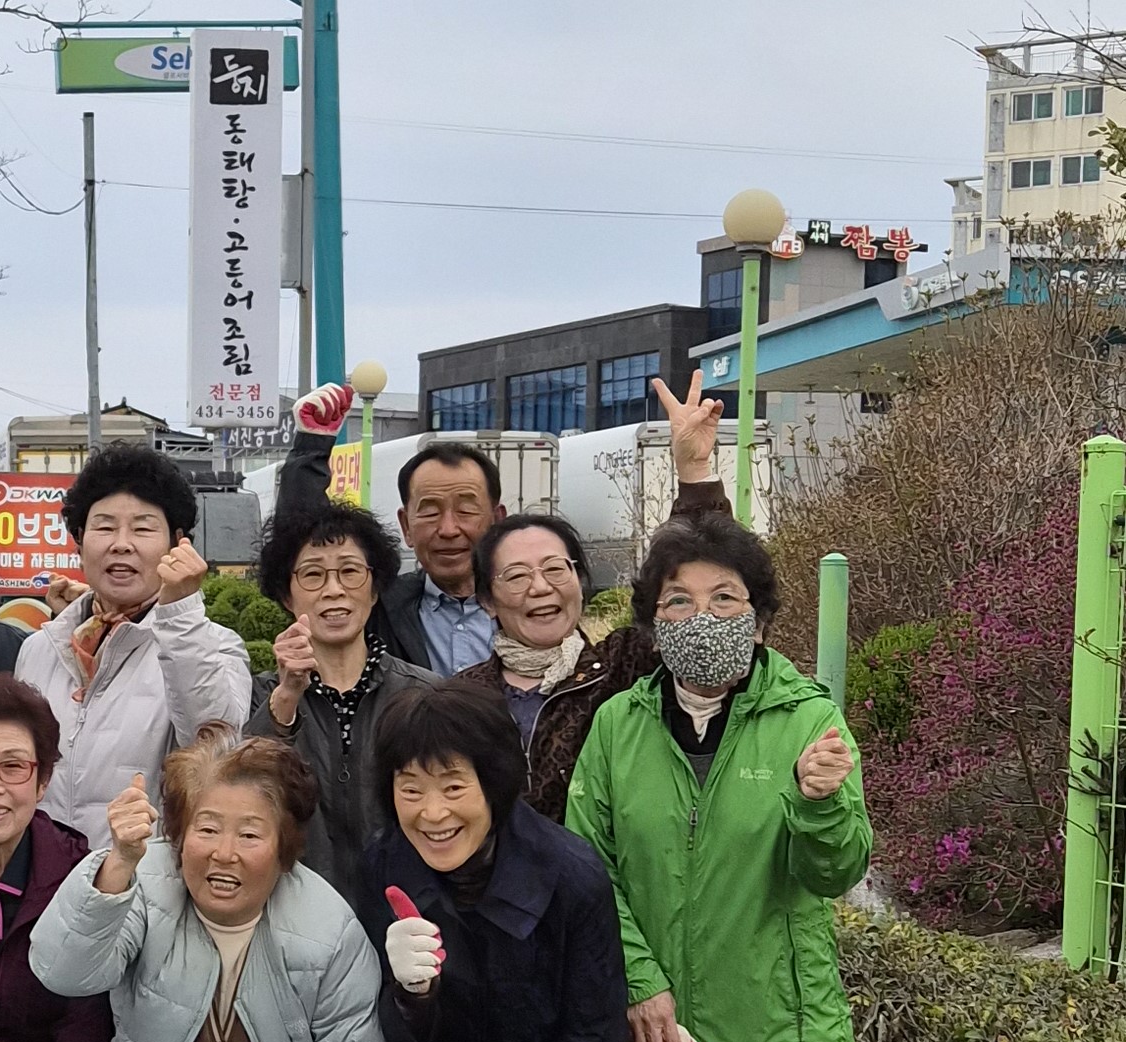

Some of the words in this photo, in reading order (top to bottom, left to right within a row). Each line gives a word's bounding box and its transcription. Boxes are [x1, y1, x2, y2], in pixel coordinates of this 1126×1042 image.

[840, 224, 920, 262] 짬뽕
[209, 383, 262, 401] 전문점
[195, 405, 275, 419] 434-3456
